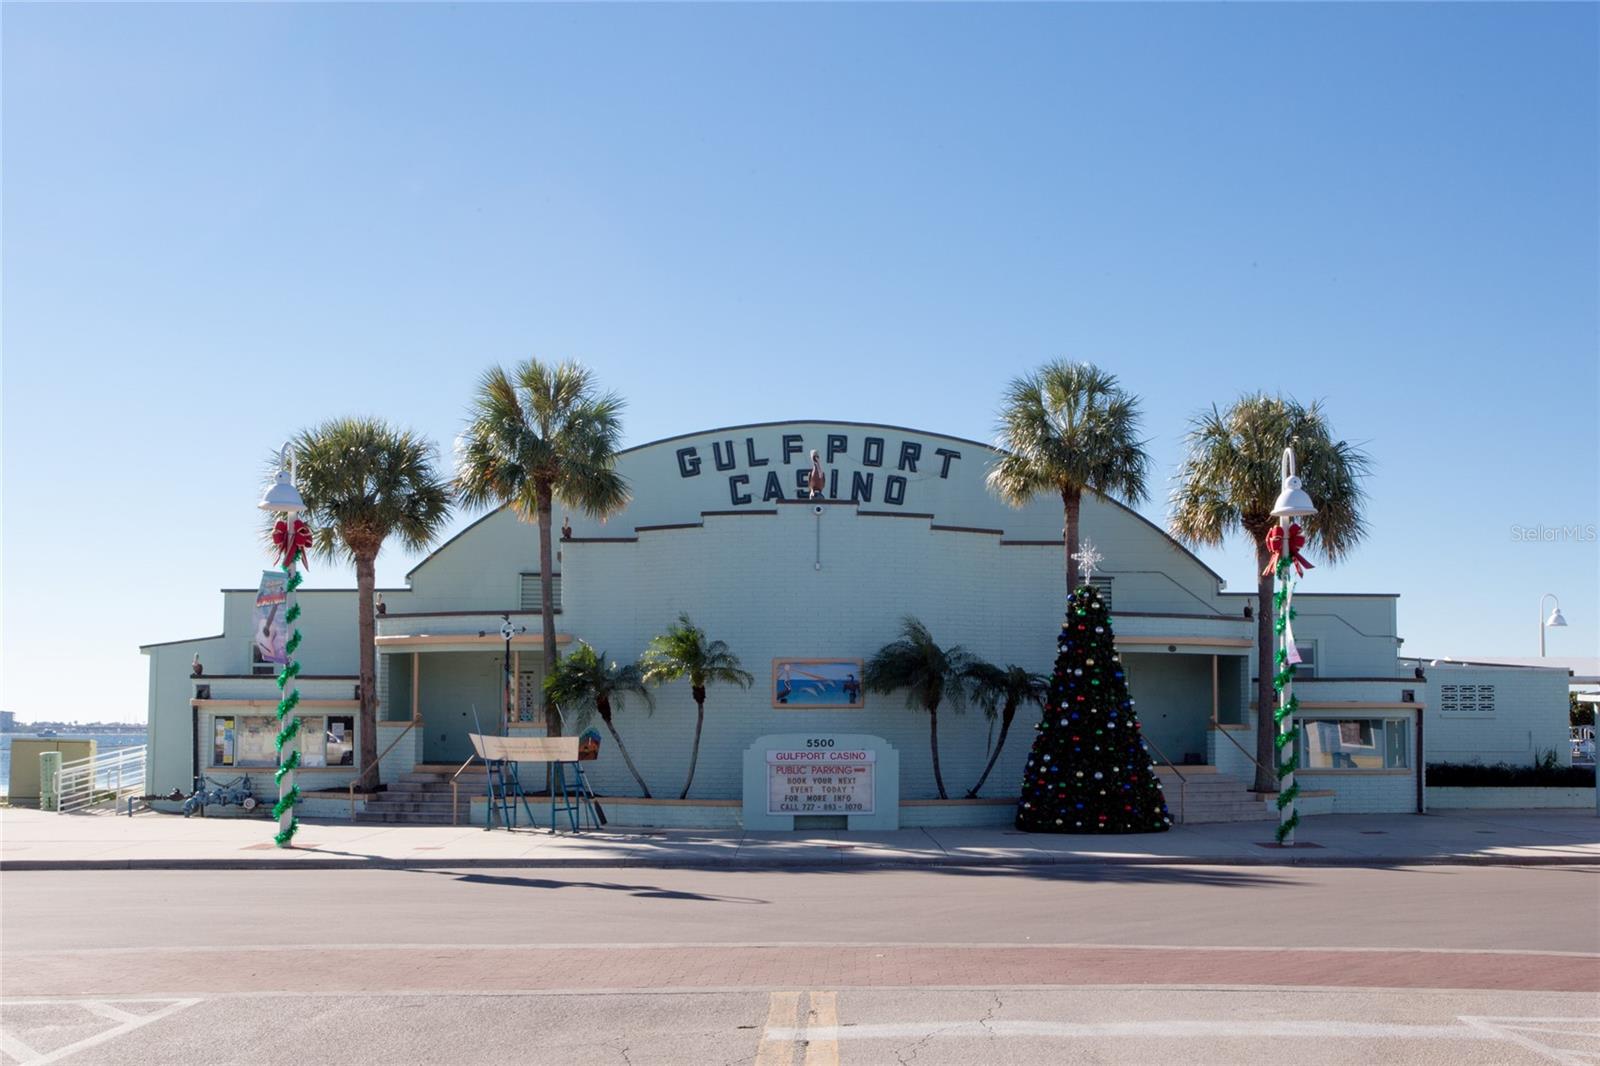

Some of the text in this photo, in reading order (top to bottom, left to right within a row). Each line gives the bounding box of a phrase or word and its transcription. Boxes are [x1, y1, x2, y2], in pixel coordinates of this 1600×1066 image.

[676, 434, 962, 479] GULFPORT
[728, 468, 908, 506] CASINO
[806, 739, 835, 748] 5500
[776, 752, 866, 760] GULFPORT CASINO
[776, 766, 853, 774] PUBLIC PARKING
[787, 777, 807, 785] BOOK
[813, 777, 833, 785] YOUR
[790, 786, 814, 794] EVENT
[822, 786, 847, 794] TODAY
[780, 803, 798, 811] CALL
